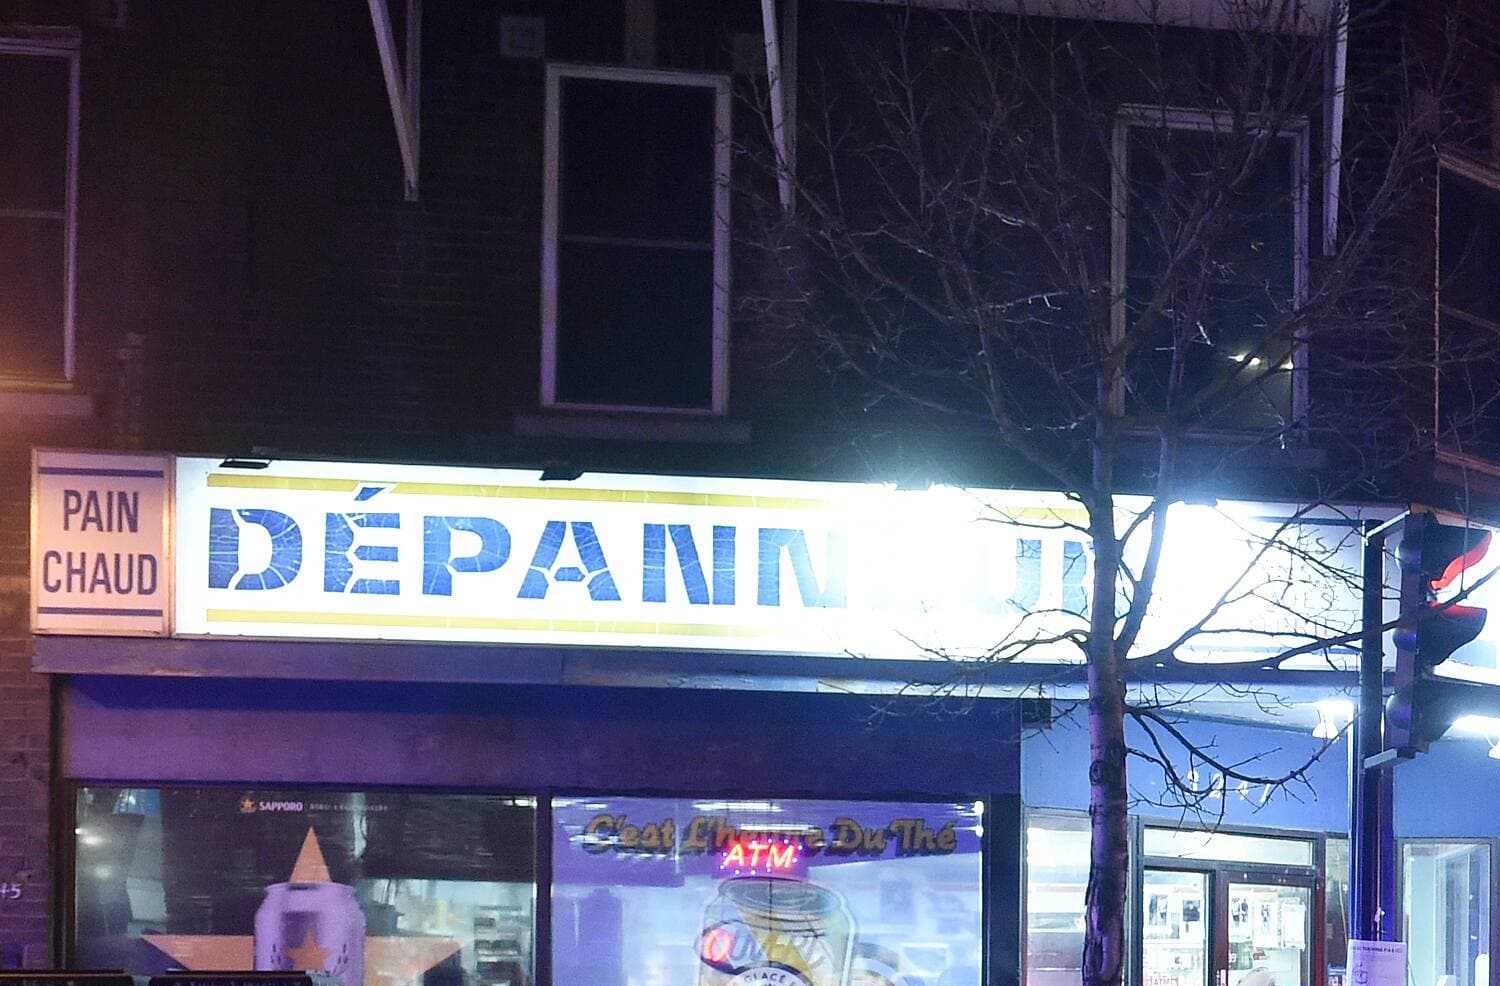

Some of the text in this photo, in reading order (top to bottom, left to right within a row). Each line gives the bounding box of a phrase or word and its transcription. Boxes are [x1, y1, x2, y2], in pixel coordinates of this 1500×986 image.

[62, 489, 140, 533] PAIN
[42, 549, 158, 596] CHAUD
[258, 801, 304, 812] SAPPORO
[584, 813, 676, 855] C'est
[828, 816, 886, 856] Du
[887, 817, 959, 856] Thé
[723, 843, 796, 869] ATM
